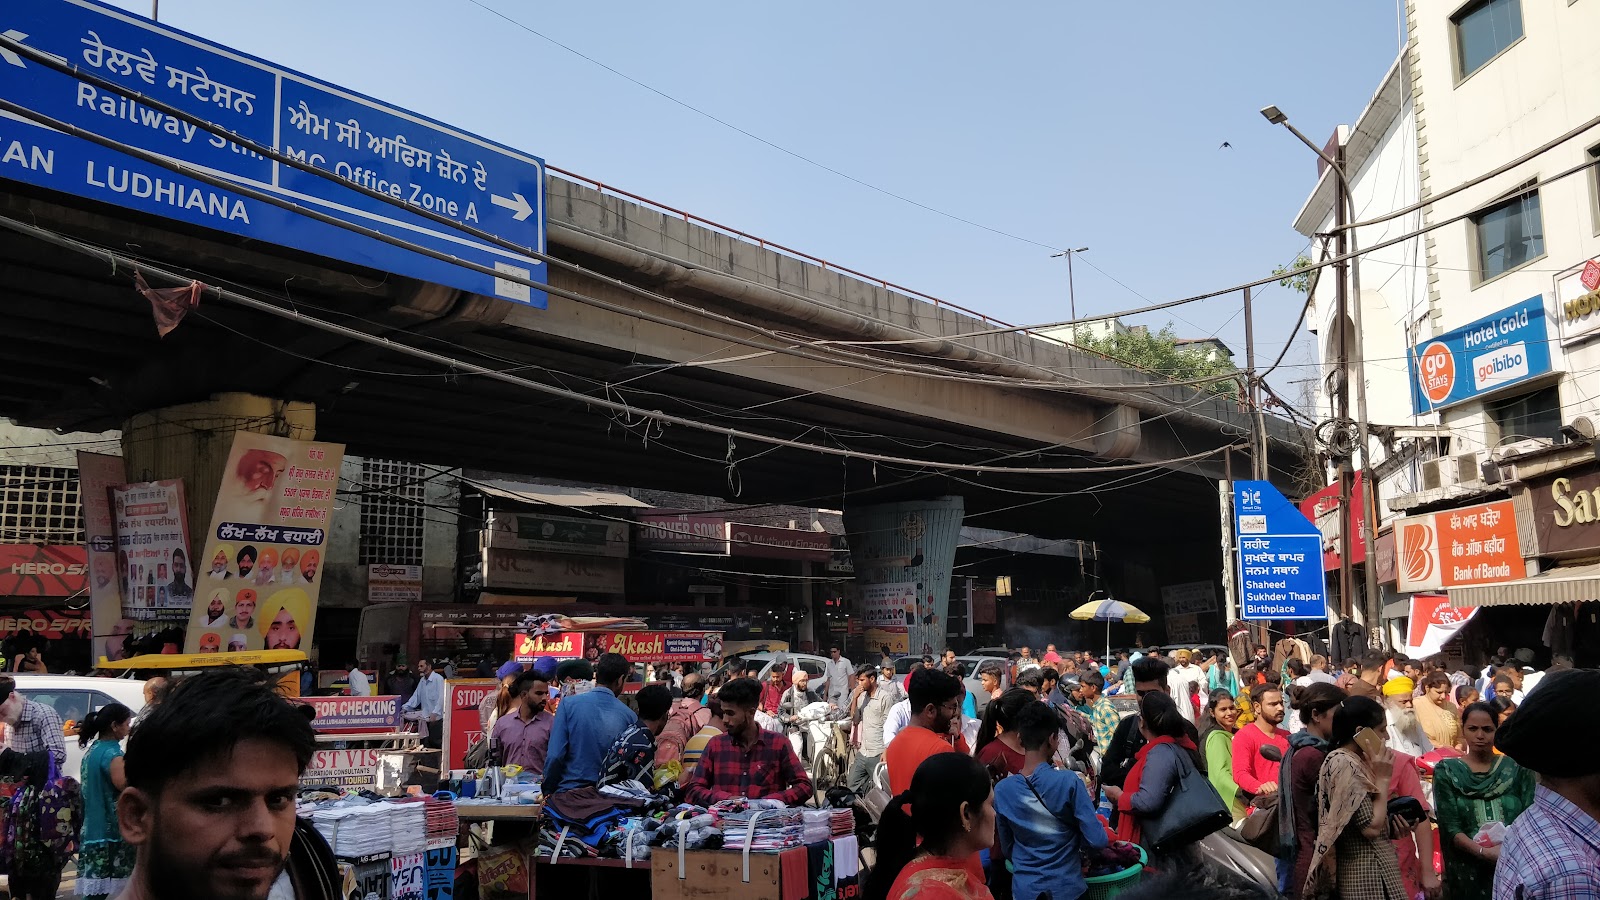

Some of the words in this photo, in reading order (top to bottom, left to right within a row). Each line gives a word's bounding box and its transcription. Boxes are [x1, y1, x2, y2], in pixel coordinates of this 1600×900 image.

[80, 30, 158, 84] ਰੇਲਵੇ
[165, 66, 257, 116] ਸਟੇਸ਼ਨ
[77, 81, 198, 144] Railway
[288, 100, 330, 140] ਐਮ
[335, 119, 361, 149] ਸੀ
[366, 131, 432, 173] ਆਫਿਸ
[472, 160, 488, 192] ਏ
[86, 160, 251, 225] LUDHIANA
[335, 161, 403, 199] Office
[407, 183, 460, 217] Zone
[464, 201, 480, 224] A
[1465, 320, 1499, 349] Hotel
[1499, 307, 1529, 336] Gold
[1426, 352, 1446, 379] go
[1478, 352, 1523, 382] goibibo
[1428, 373, 1449, 389] STAYS
[694, 523, 723, 541] SONS
[795, 539, 828, 551] Finance
[1244, 552, 1275, 565] ਸੁਖਦੇਵ
[11, 562, 65, 575] HERO
[1245, 566, 1269, 576] ਜਨਮ
[1453, 565, 1473, 581] Bank
[1473, 565, 1481, 580] of
[1482, 562, 1510, 579] Baroda
[1246, 580, 1286, 589] Shaheed
[1247, 592, 1286, 601] Sukhdev
[1289, 592, 1321, 602] Thapar
[1247, 604, 1296, 614] Birthplace
[519, 635, 573, 655] Akash
[608, 633, 663, 655] Akash
[457, 689, 484, 706] STOP
[315, 701, 337, 717] FOR
[339, 700, 396, 717] CHECKING
[334, 767, 370, 775] CONSULTANTS
[302, 778, 324, 786] STUDY
[325, 777, 340, 785] VISA
[344, 776, 372, 784] TOURIST
[391, 866, 424, 889] USA
